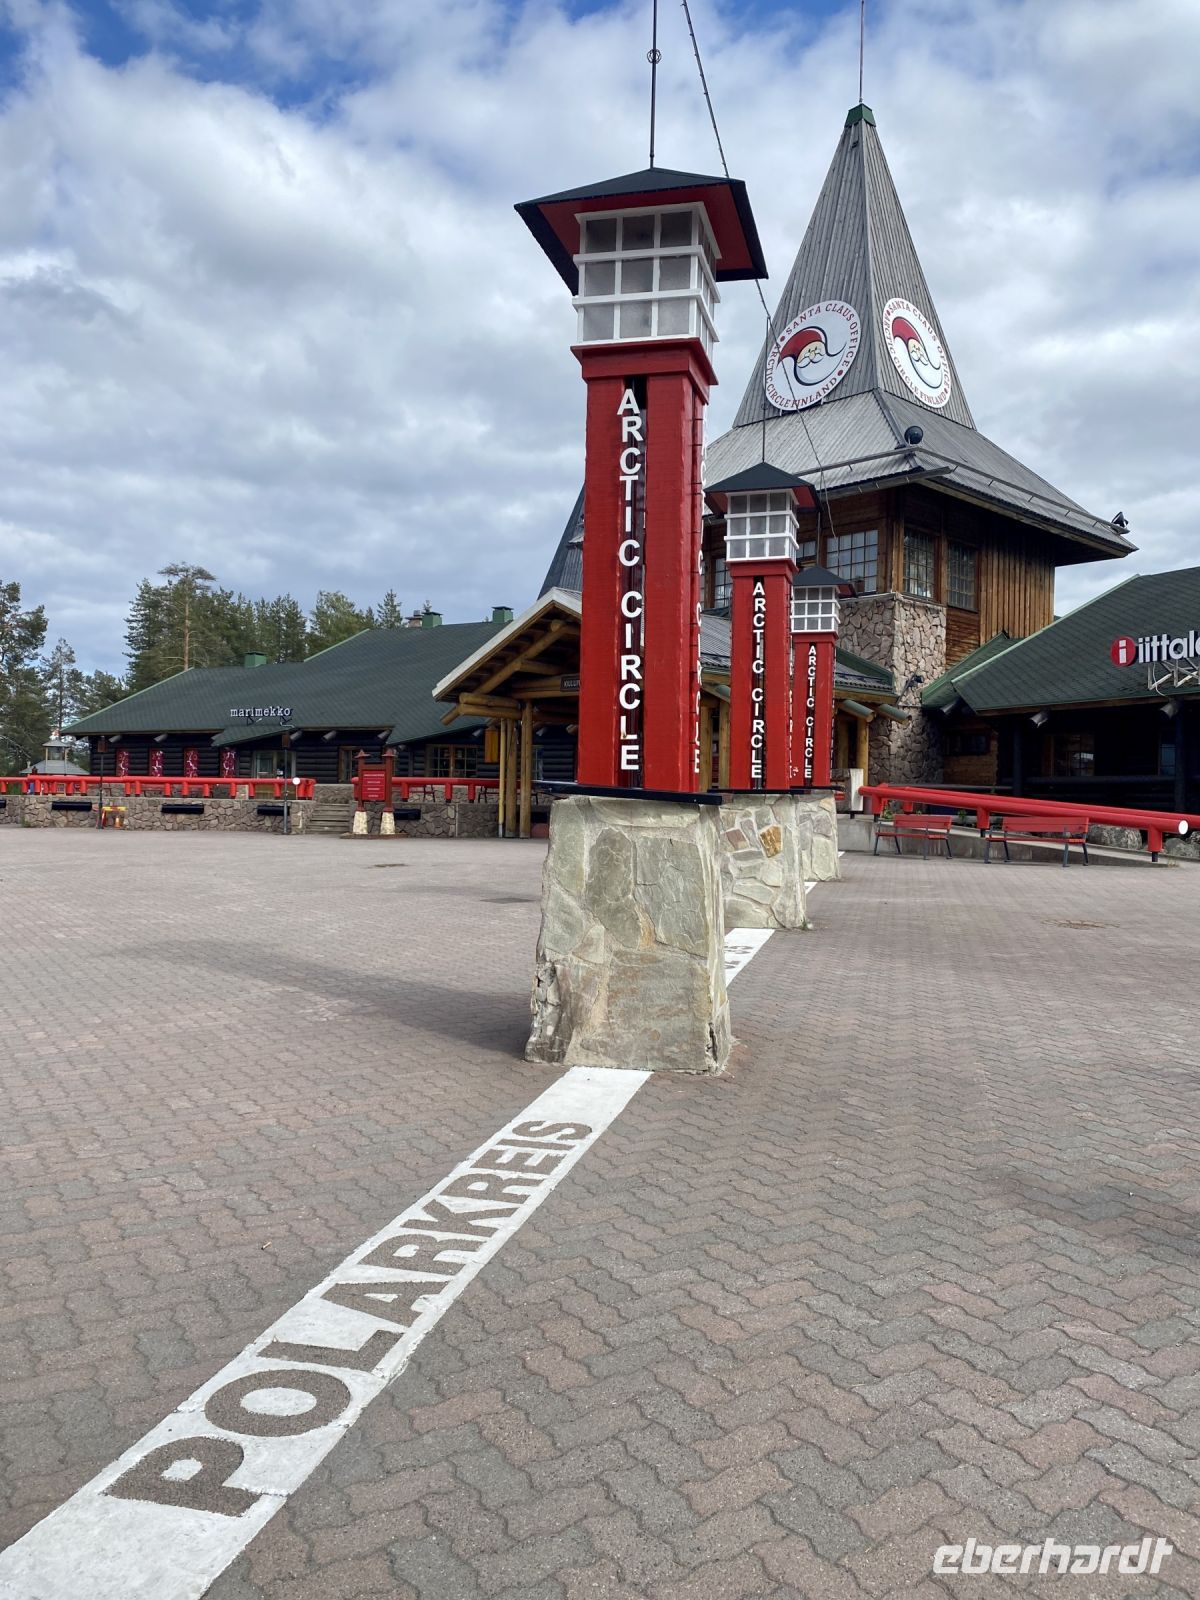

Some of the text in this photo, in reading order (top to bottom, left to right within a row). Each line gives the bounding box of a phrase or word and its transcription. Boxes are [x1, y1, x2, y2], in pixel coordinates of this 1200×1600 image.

[785, 303, 859, 367] SANTA CLAUS OFFICE
[883, 313, 947, 405] ARCTIC CIRCLE FINLAND
[888, 300, 911, 313] SANTA
[912, 308, 937, 342] CLAUS
[766, 344, 837, 408] ARCTIC CIRCLE FINLAND
[617, 388, 643, 770] ARCTIC CIRCLE
[750, 582, 766, 778] ARCTIC CIRCLE
[1138, 630, 1200, 663] iittal
[230, 706, 291, 717] marimekko
[804, 645, 817, 778] ARCTIC CIRCLE
[102, 1119, 593, 1518] POLARKREIS
